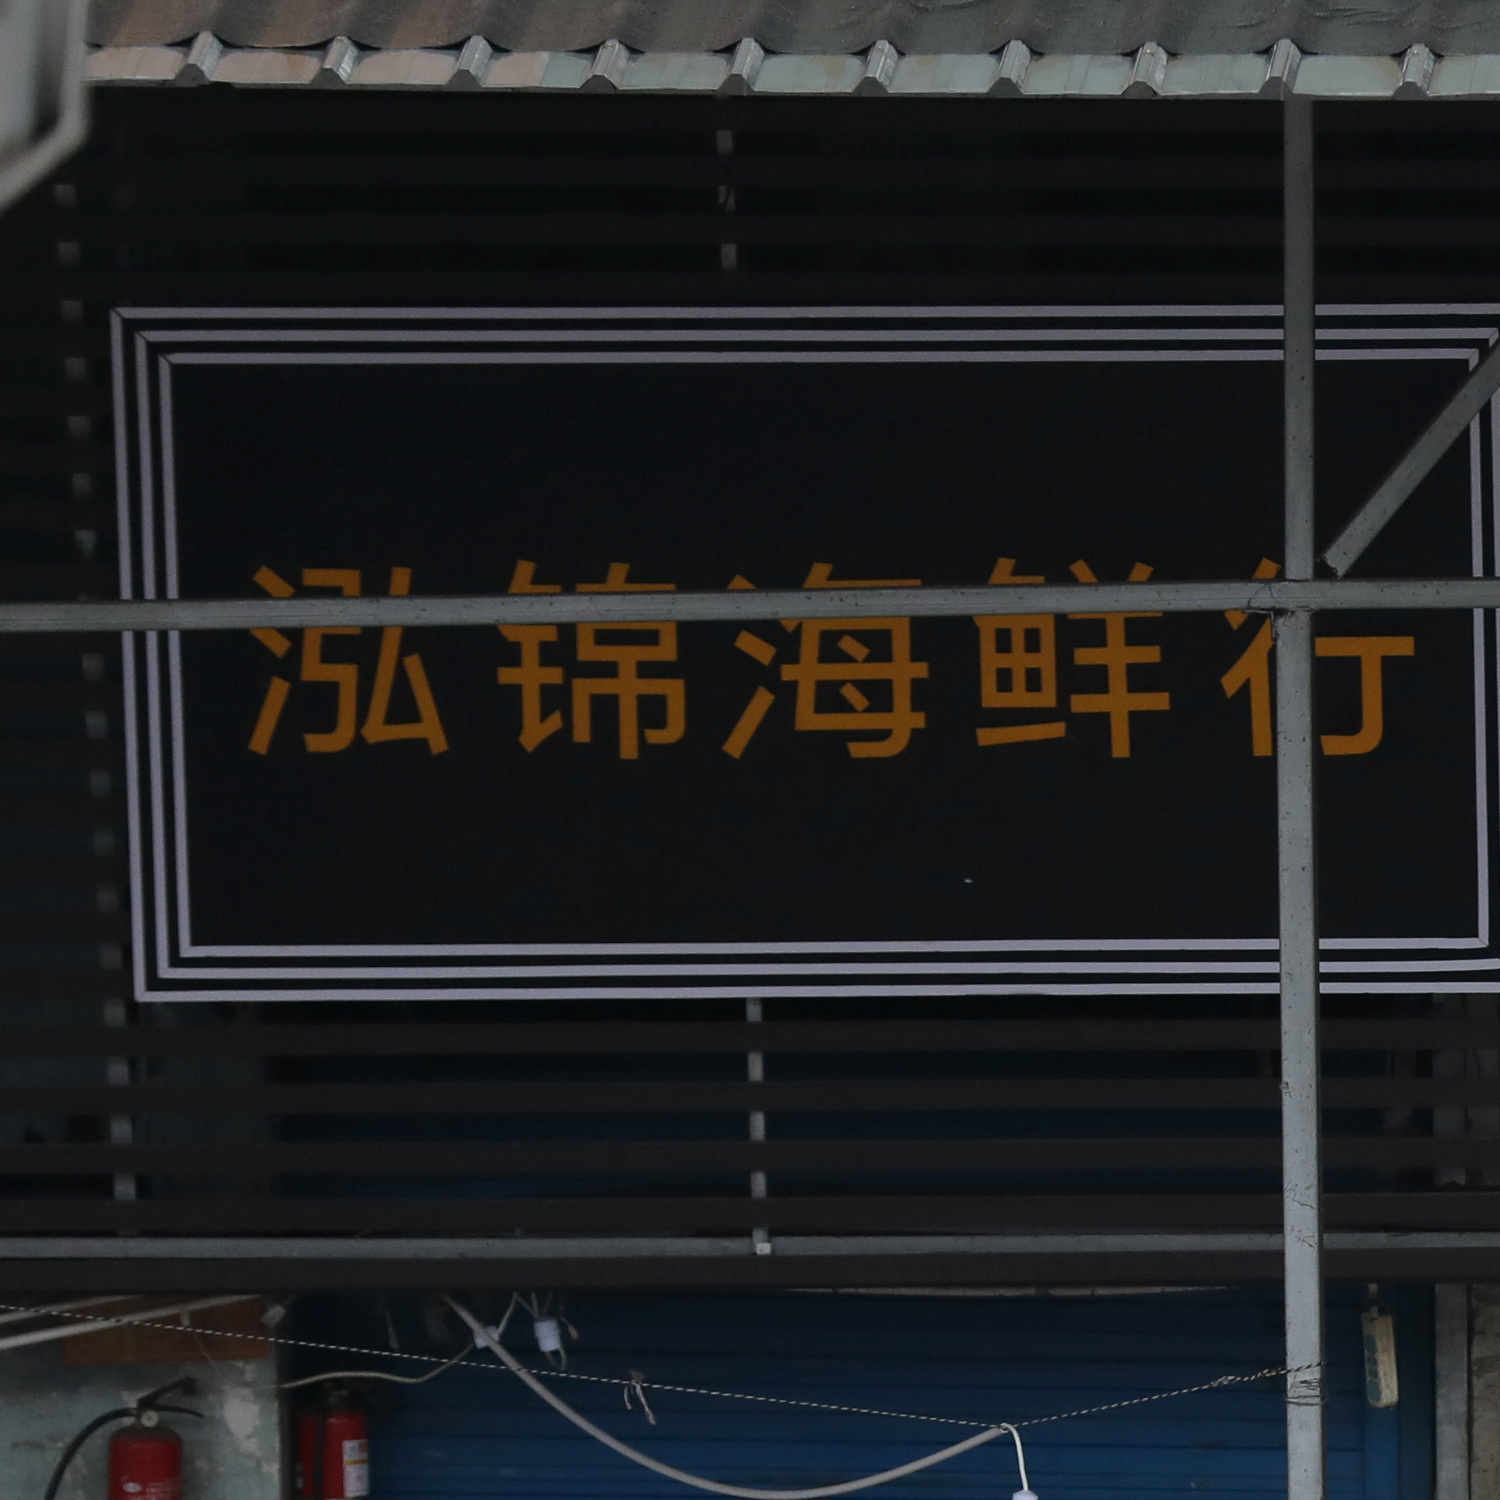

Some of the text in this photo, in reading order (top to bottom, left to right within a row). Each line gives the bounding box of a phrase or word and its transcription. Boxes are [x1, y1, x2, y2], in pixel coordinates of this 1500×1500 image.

[248, 556, 1415, 760] 泓锦海鲜行
